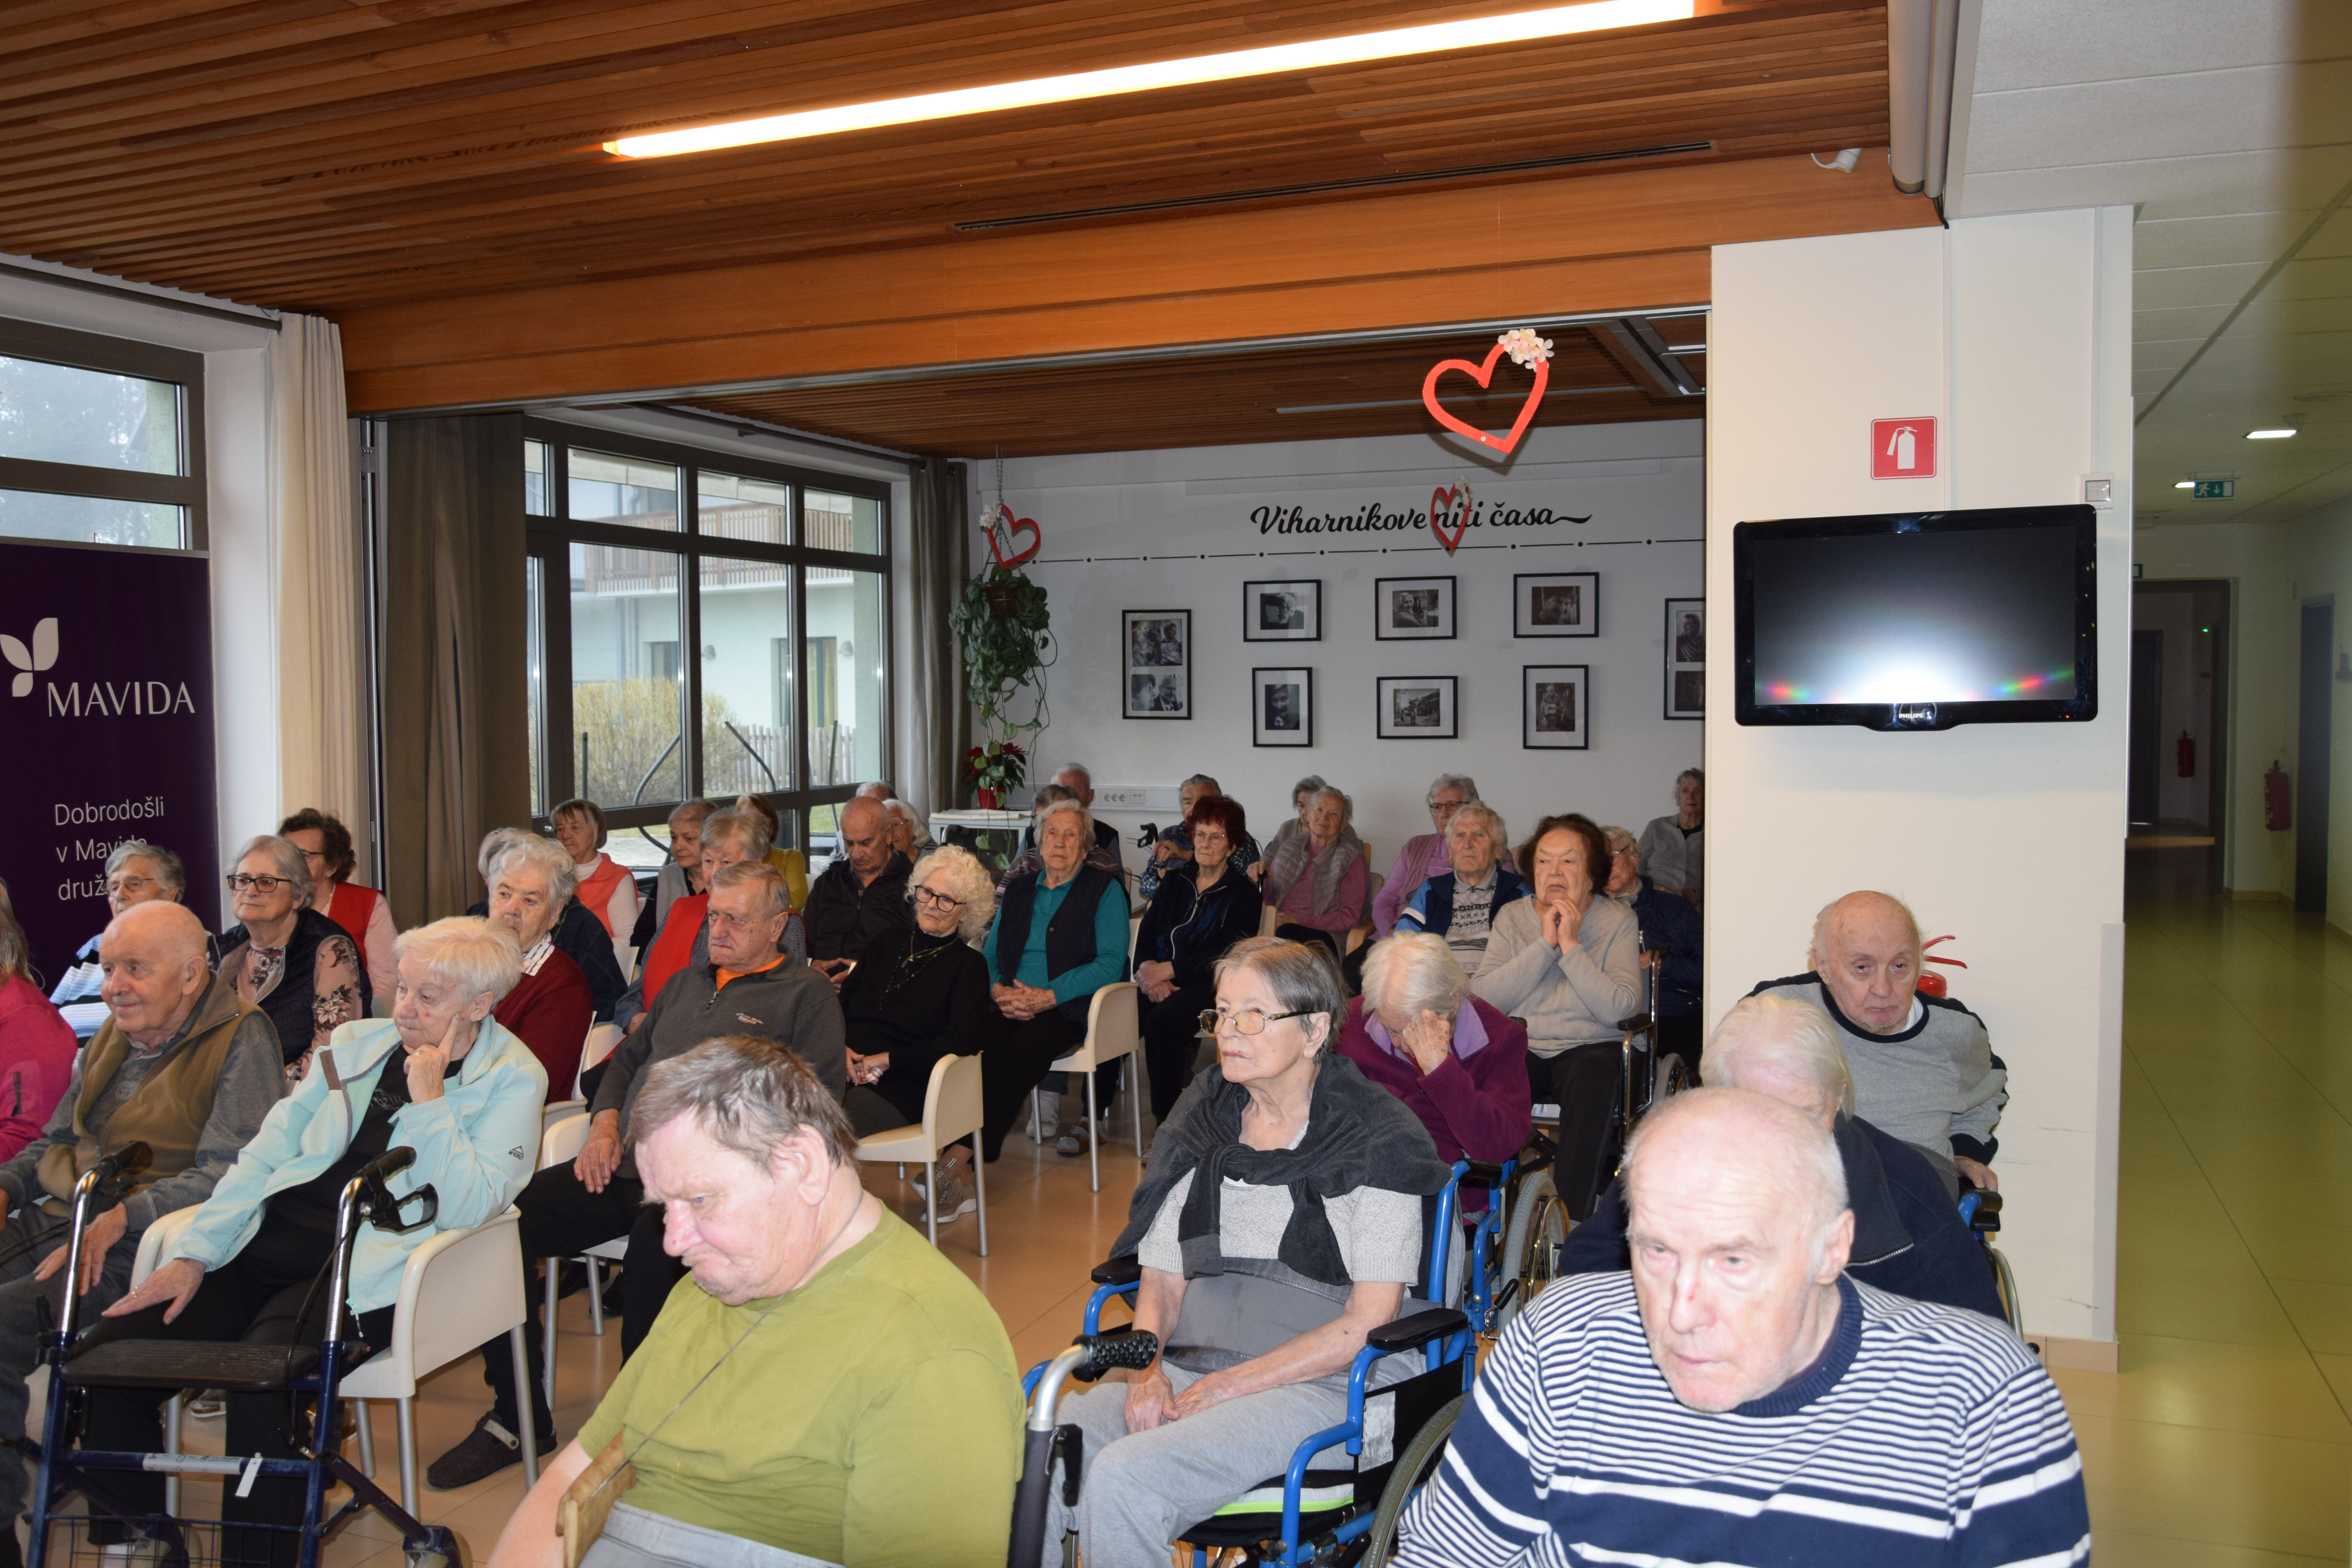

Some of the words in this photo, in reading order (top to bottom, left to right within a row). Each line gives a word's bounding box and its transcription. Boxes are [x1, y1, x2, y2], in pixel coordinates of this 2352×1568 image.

[1250, 502, 1427, 535] Viharnikove
[1490, 501, 1592, 526] časa
[47, 681, 196, 717] MAVIDA
[54, 796, 164, 826] Dobrodošli
[56, 846, 68, 863] v
